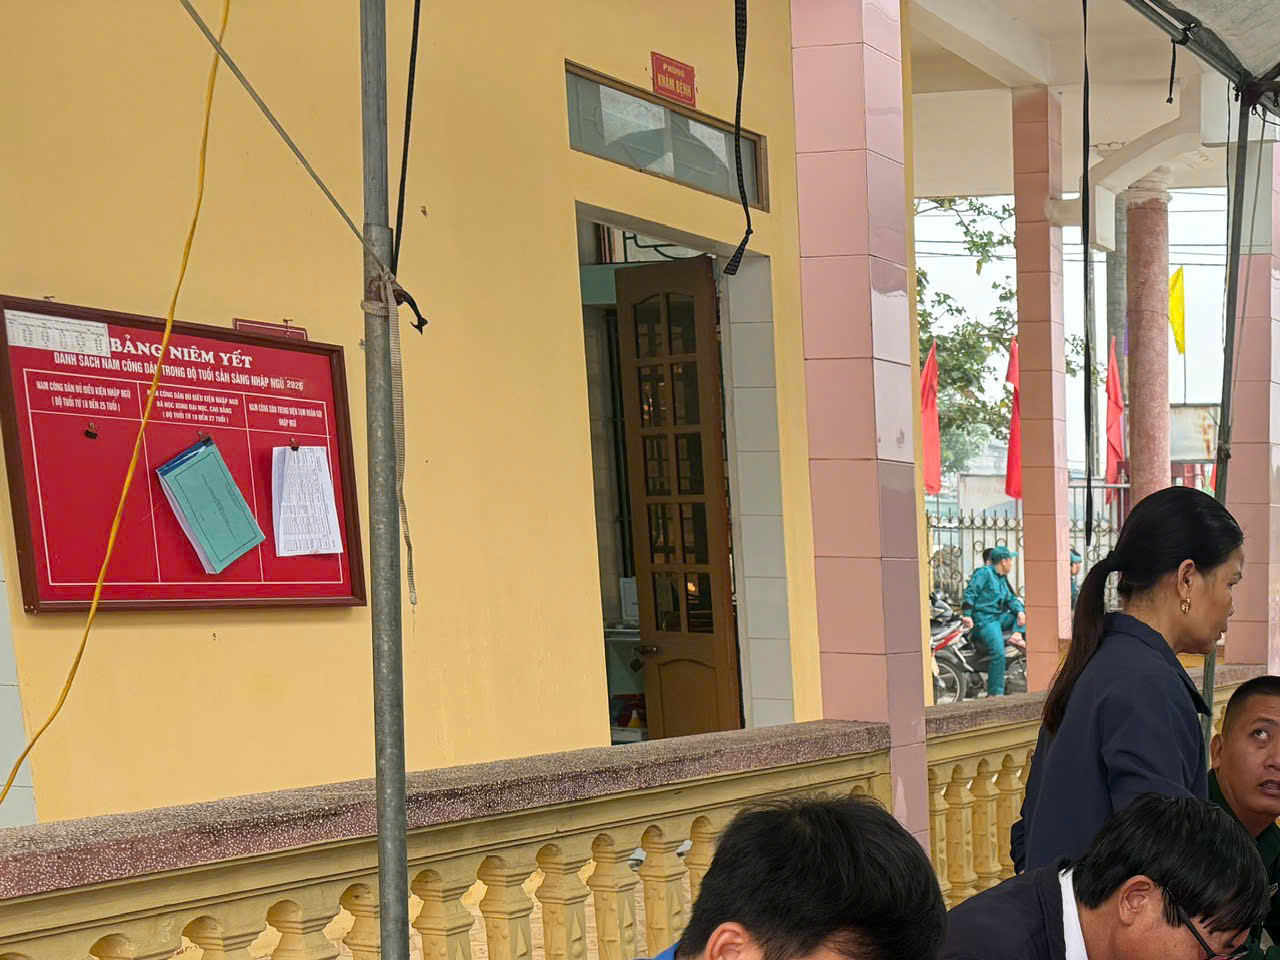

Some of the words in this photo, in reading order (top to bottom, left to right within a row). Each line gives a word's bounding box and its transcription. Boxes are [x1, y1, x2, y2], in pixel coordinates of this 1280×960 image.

[54, 351, 77, 366] DANH
[101, 357, 120, 370] NAM
[122, 358, 143, 373] CÔNG
[161, 364, 186, 378] TRONG
[168, 345, 215, 364] NIÊM
[219, 349, 253, 368] YẾT
